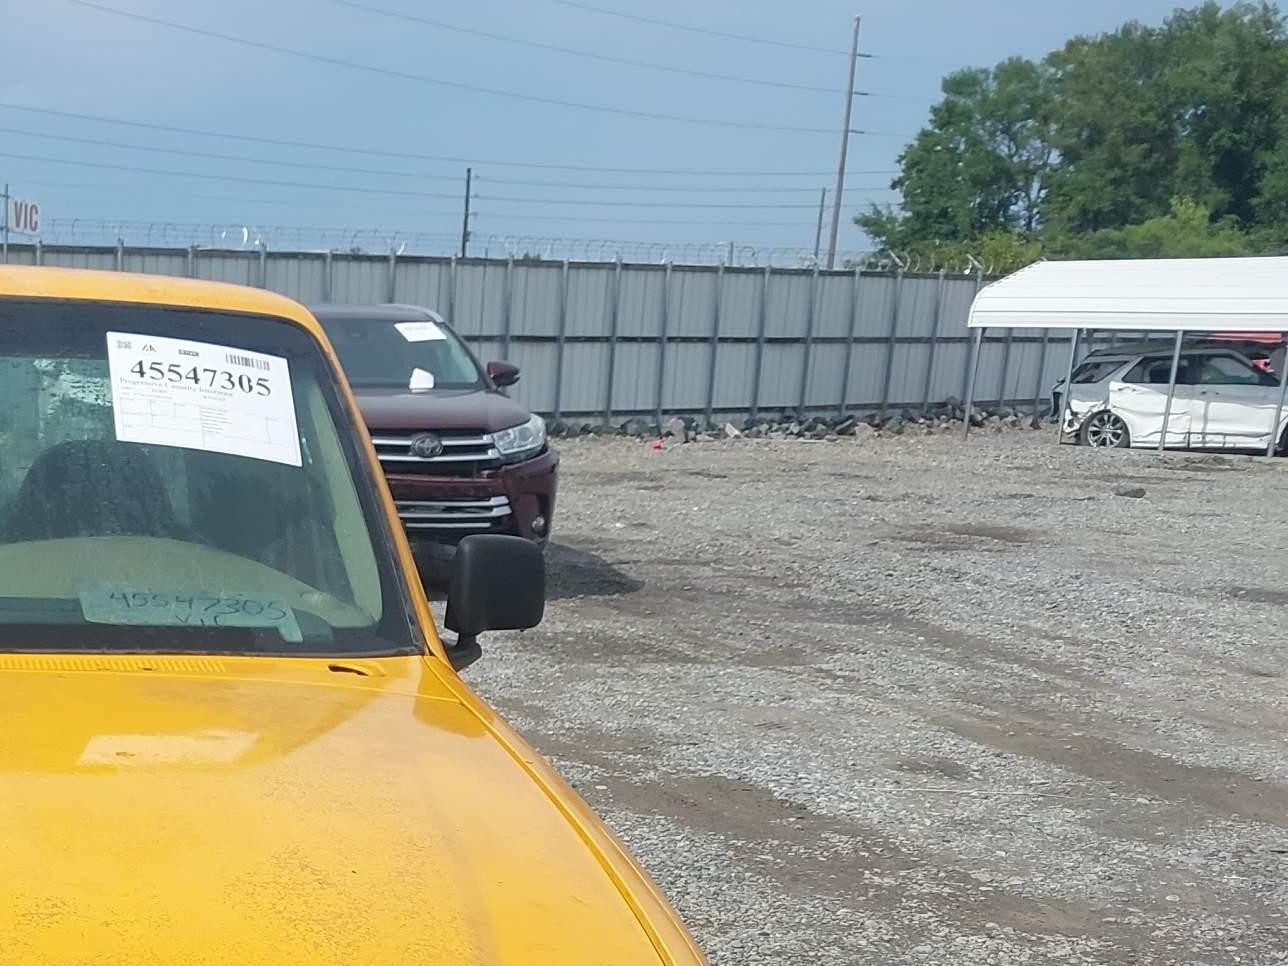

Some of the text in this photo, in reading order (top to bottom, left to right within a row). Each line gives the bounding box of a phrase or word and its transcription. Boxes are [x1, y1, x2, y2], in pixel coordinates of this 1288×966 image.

[14, 201, 39, 232] VIC
[130, 359, 272, 397] 45547305
[110, 591, 287, 621] 45547305
